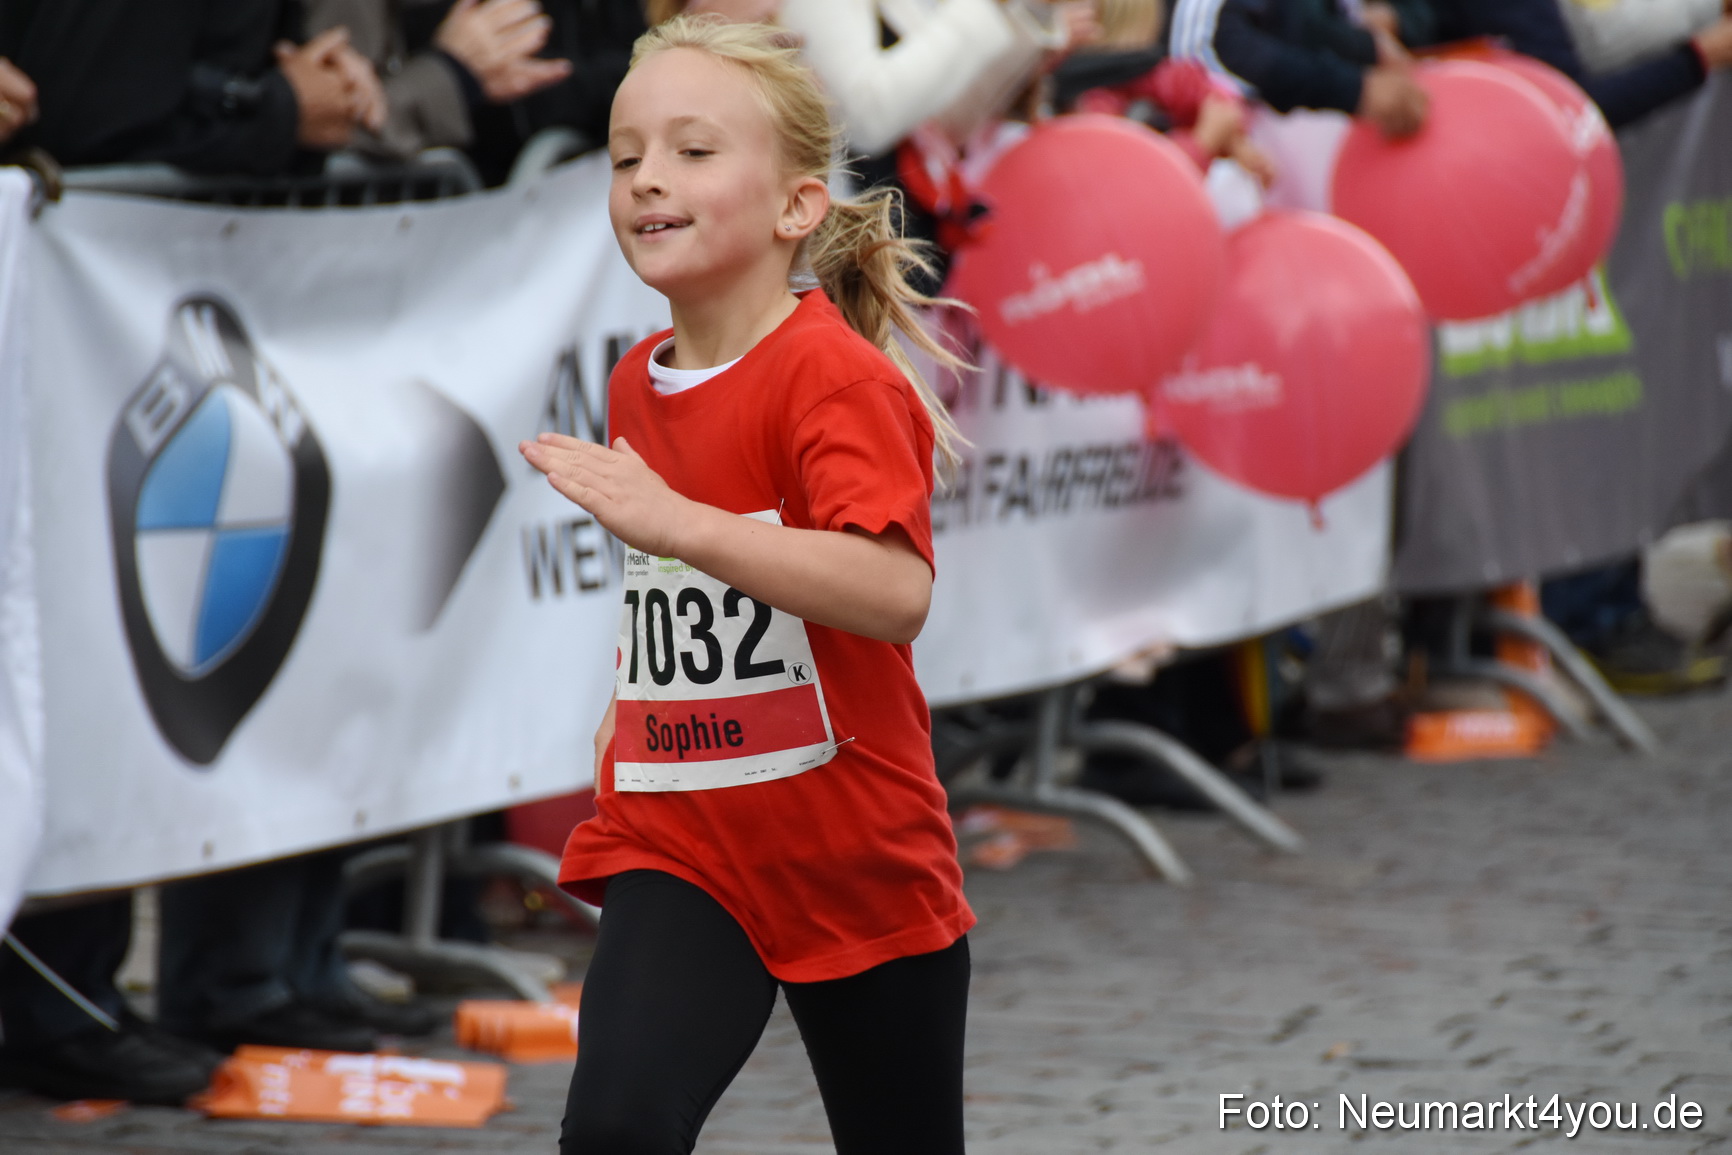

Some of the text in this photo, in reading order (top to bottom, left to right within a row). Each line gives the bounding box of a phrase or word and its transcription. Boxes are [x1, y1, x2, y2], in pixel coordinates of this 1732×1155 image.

[125, 304, 304, 456] BMW
[657, 563, 684, 575] inspired
[624, 586, 786, 687] 7032
[792, 664, 807, 682] K
[645, 712, 744, 760] Sophie
